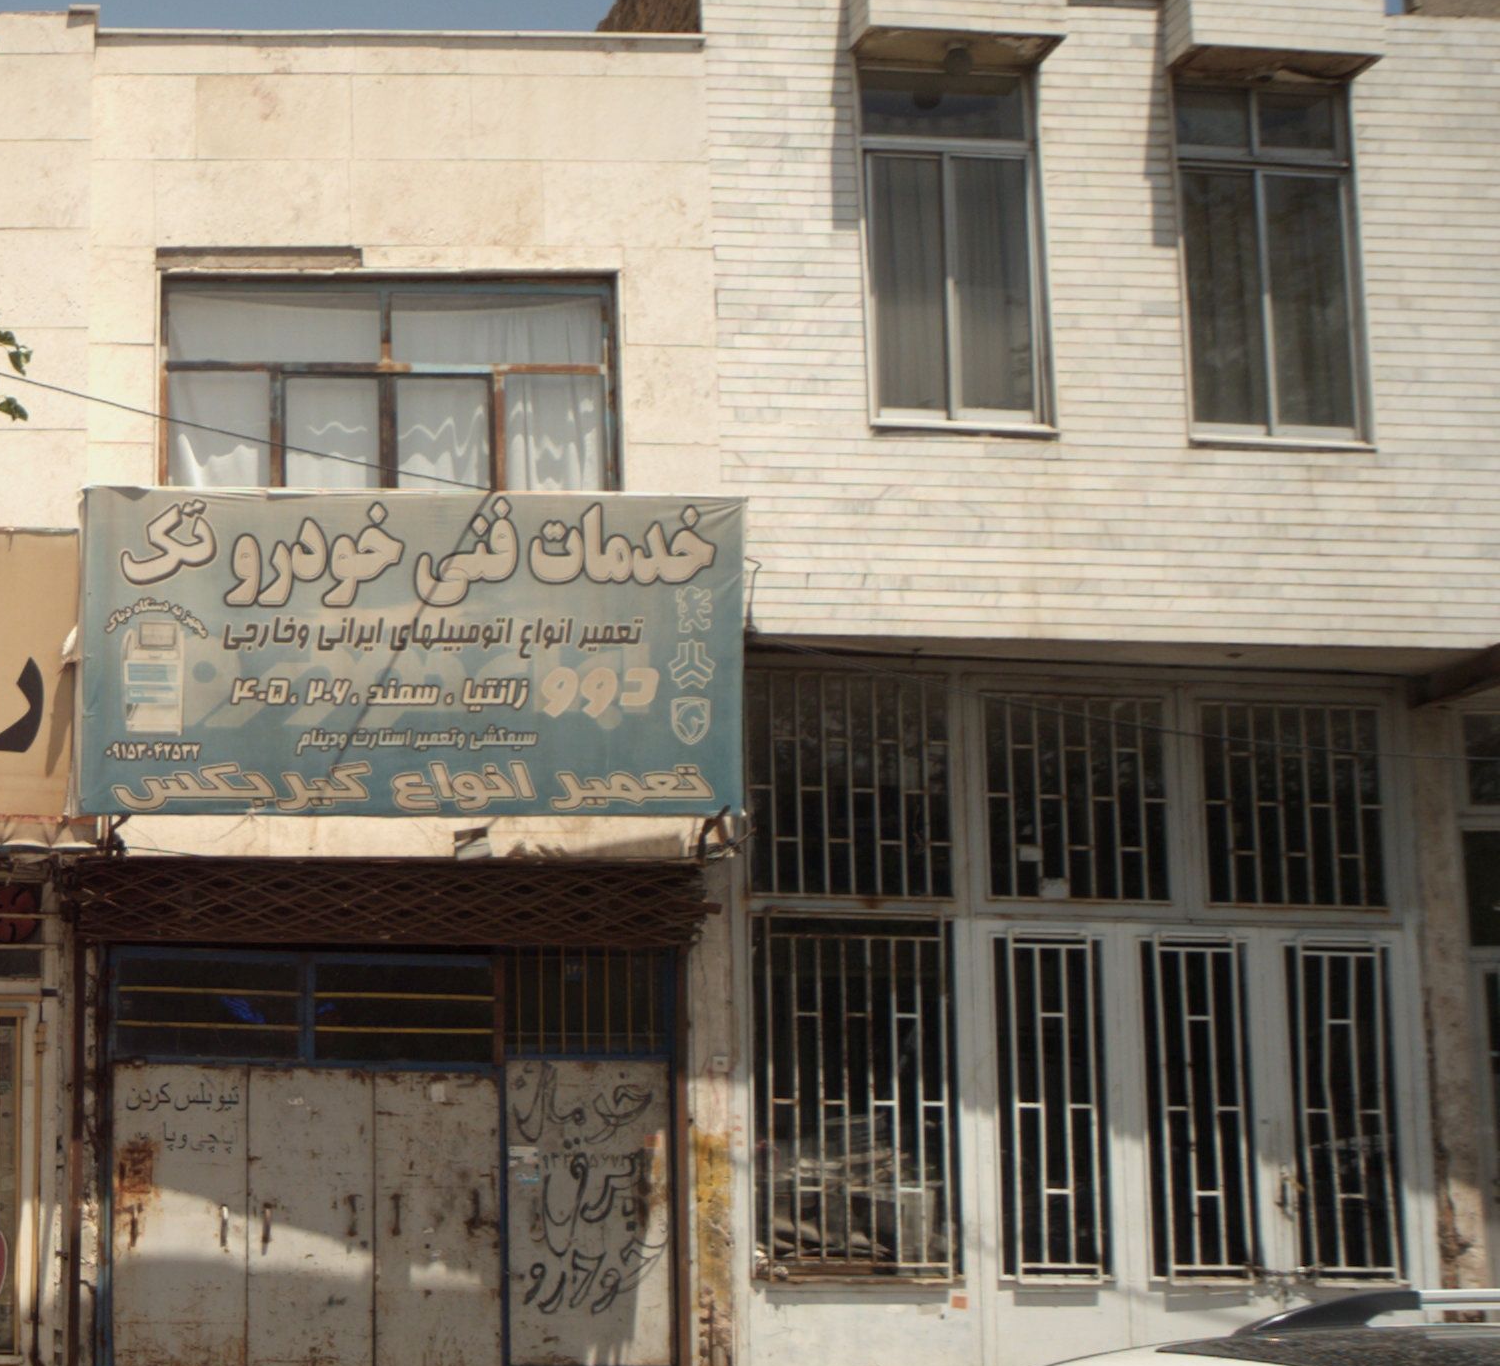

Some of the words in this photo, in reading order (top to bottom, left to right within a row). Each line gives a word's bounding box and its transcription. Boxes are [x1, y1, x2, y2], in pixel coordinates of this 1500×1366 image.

[120, 498, 218, 586] تک
[224, 502, 404, 607] خودرو
[416, 496, 518, 606] فنی
[528, 504, 716, 585] خدمات
[133, 596, 171, 615] دستگاه
[317, 616, 382, 651] ایرانی
[390, 616, 513, 652] اتومبیلهای
[519, 617, 573, 659] انواع
[578, 618, 644, 652] تعمیر
[366, 679, 440, 706] سمند
[462, 678, 529, 712] زانتیا
[541, 666, 660, 718] دوو
[351, 728, 413, 749] استارت
[391, 760, 537, 811] انواع
[551, 763, 714, 811] تعمیر
[126, 1082, 171, 1111] کردن
